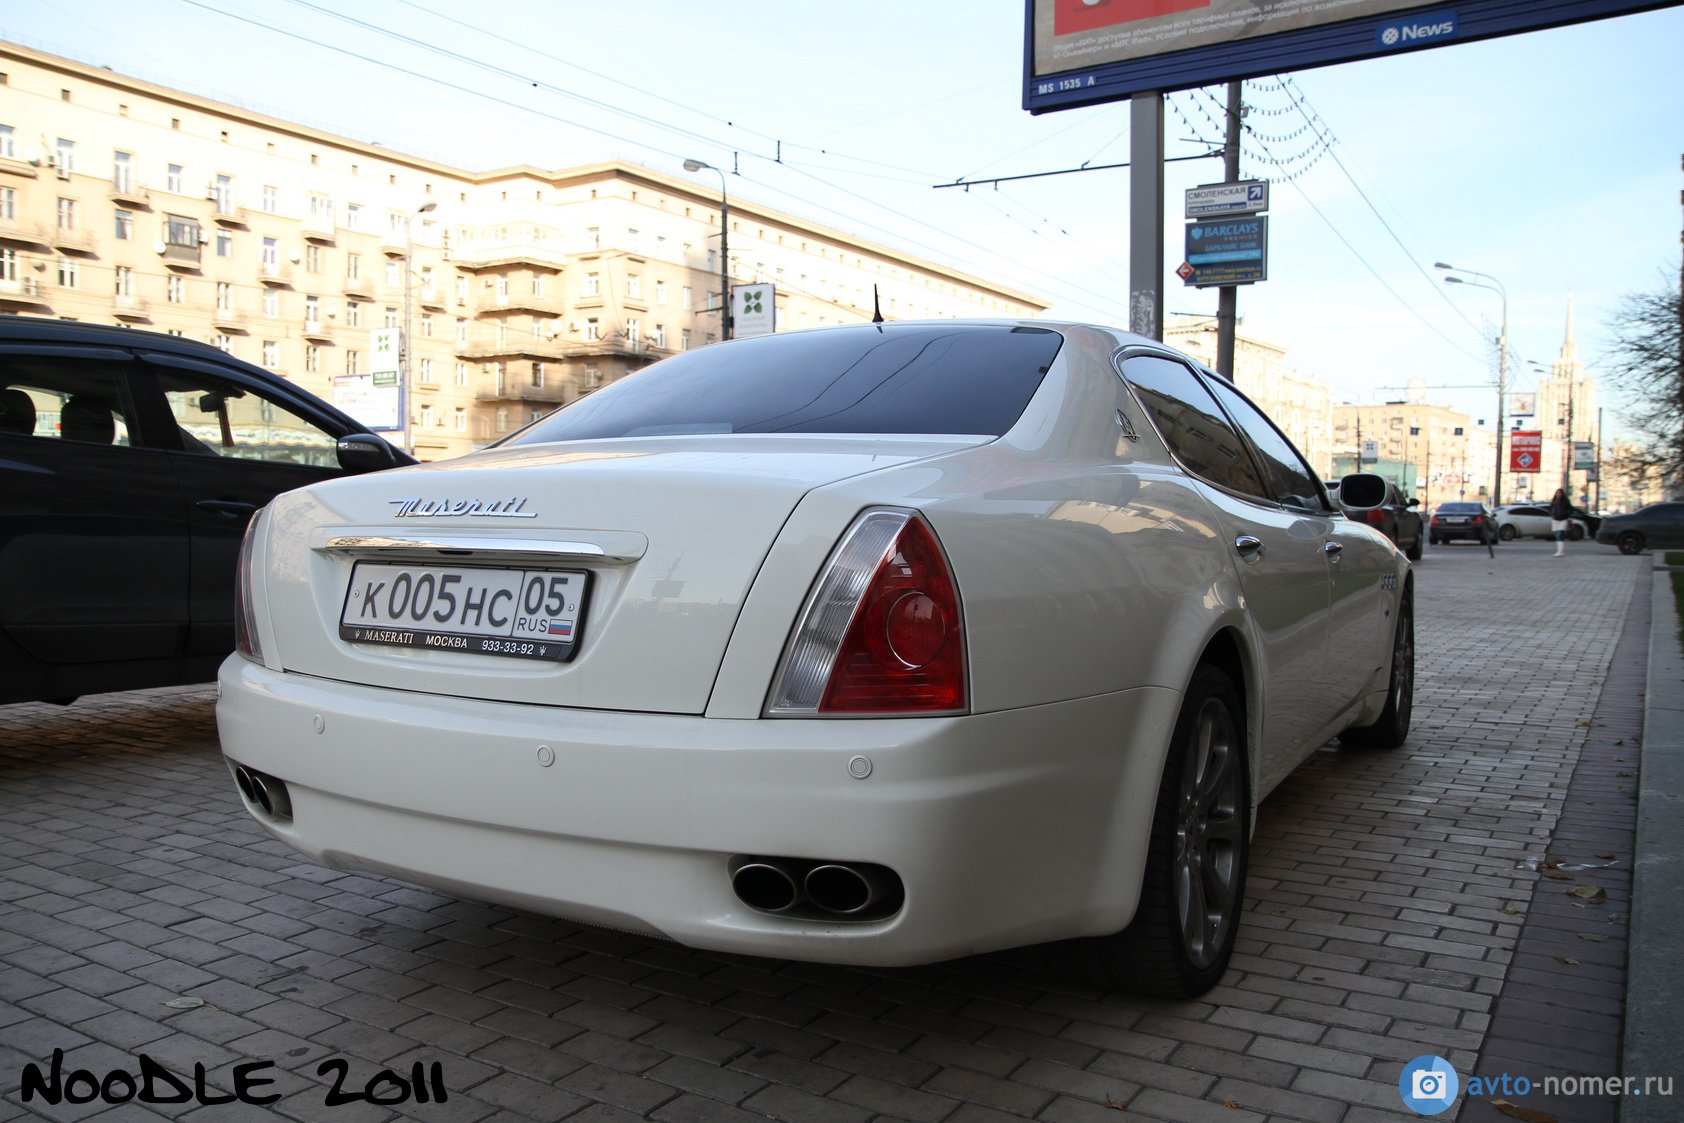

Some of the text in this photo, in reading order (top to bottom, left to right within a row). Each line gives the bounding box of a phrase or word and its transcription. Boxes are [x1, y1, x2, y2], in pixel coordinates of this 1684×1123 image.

[1038, 76, 1095, 94] MS 1535 A
[1188, 186, 1246, 200] СМОЛЕНСКАЯ
[1204, 223, 1258, 237] BARCLAYS
[388, 497, 538, 519] Maserati
[524, 576, 569, 617] 05
[517, 617, 548, 633] RUS
[364, 630, 535, 656] MASERATI МОСКВА 933-33-92
